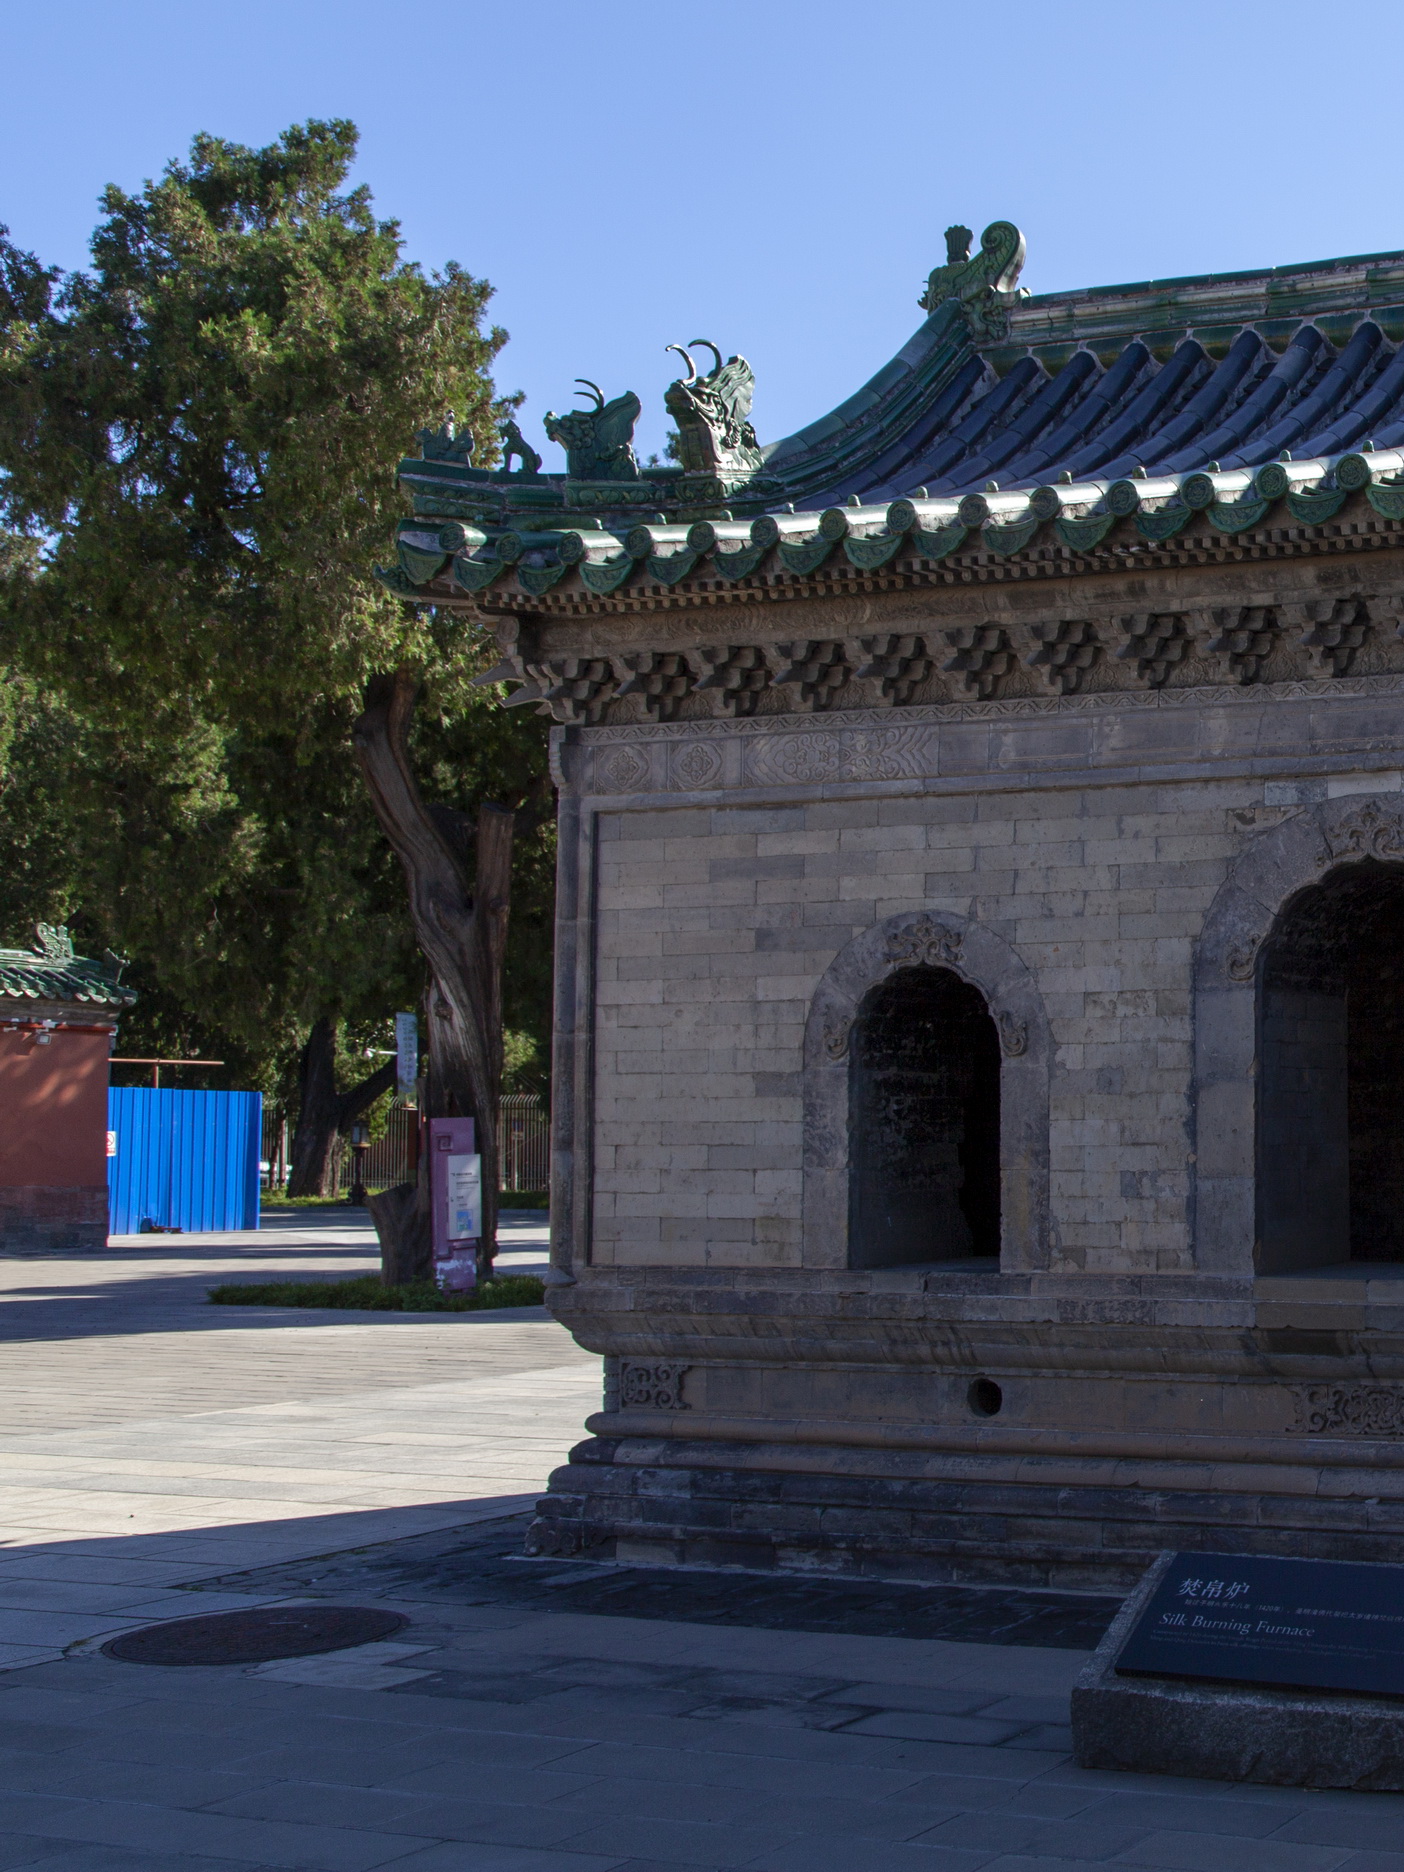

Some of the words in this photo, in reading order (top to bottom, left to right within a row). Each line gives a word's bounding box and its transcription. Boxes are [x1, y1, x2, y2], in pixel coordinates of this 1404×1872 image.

[1175, 1578, 1251, 1600] 焚帛炉
[1158, 1612, 1188, 1627] Silk
[1191, 1615, 1252, 1635] Burning
[1255, 1620, 1316, 1637] Furnace
